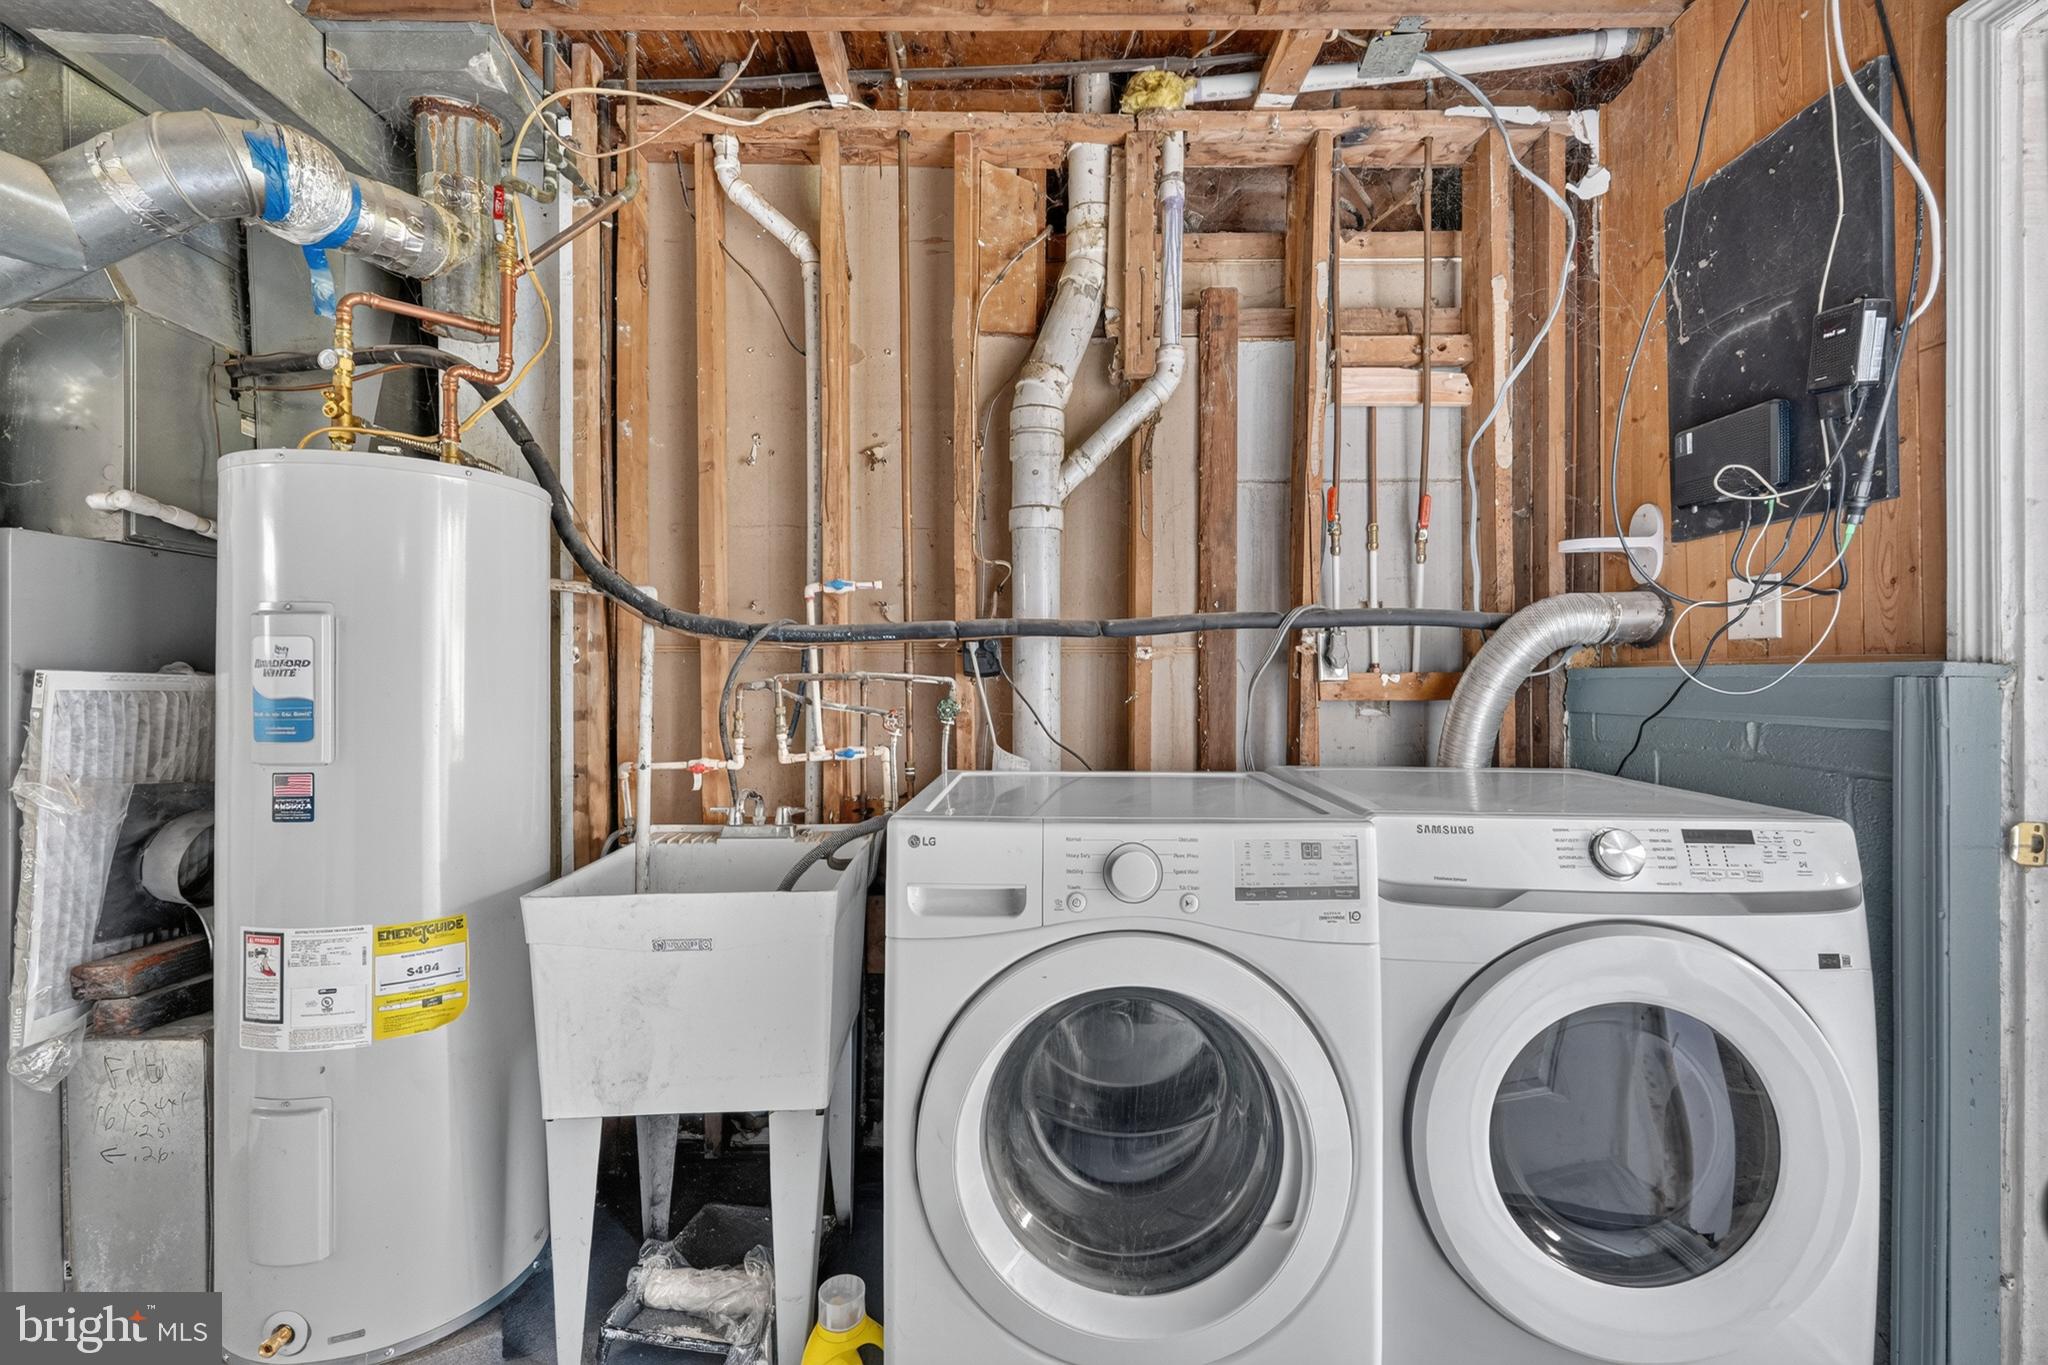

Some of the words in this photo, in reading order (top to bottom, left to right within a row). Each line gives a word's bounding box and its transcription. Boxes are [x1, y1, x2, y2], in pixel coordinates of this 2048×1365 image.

[263, 669, 296, 677] WHITE
[1416, 824, 1474, 834] SAMSUNG
[922, 836, 936, 846] LG
